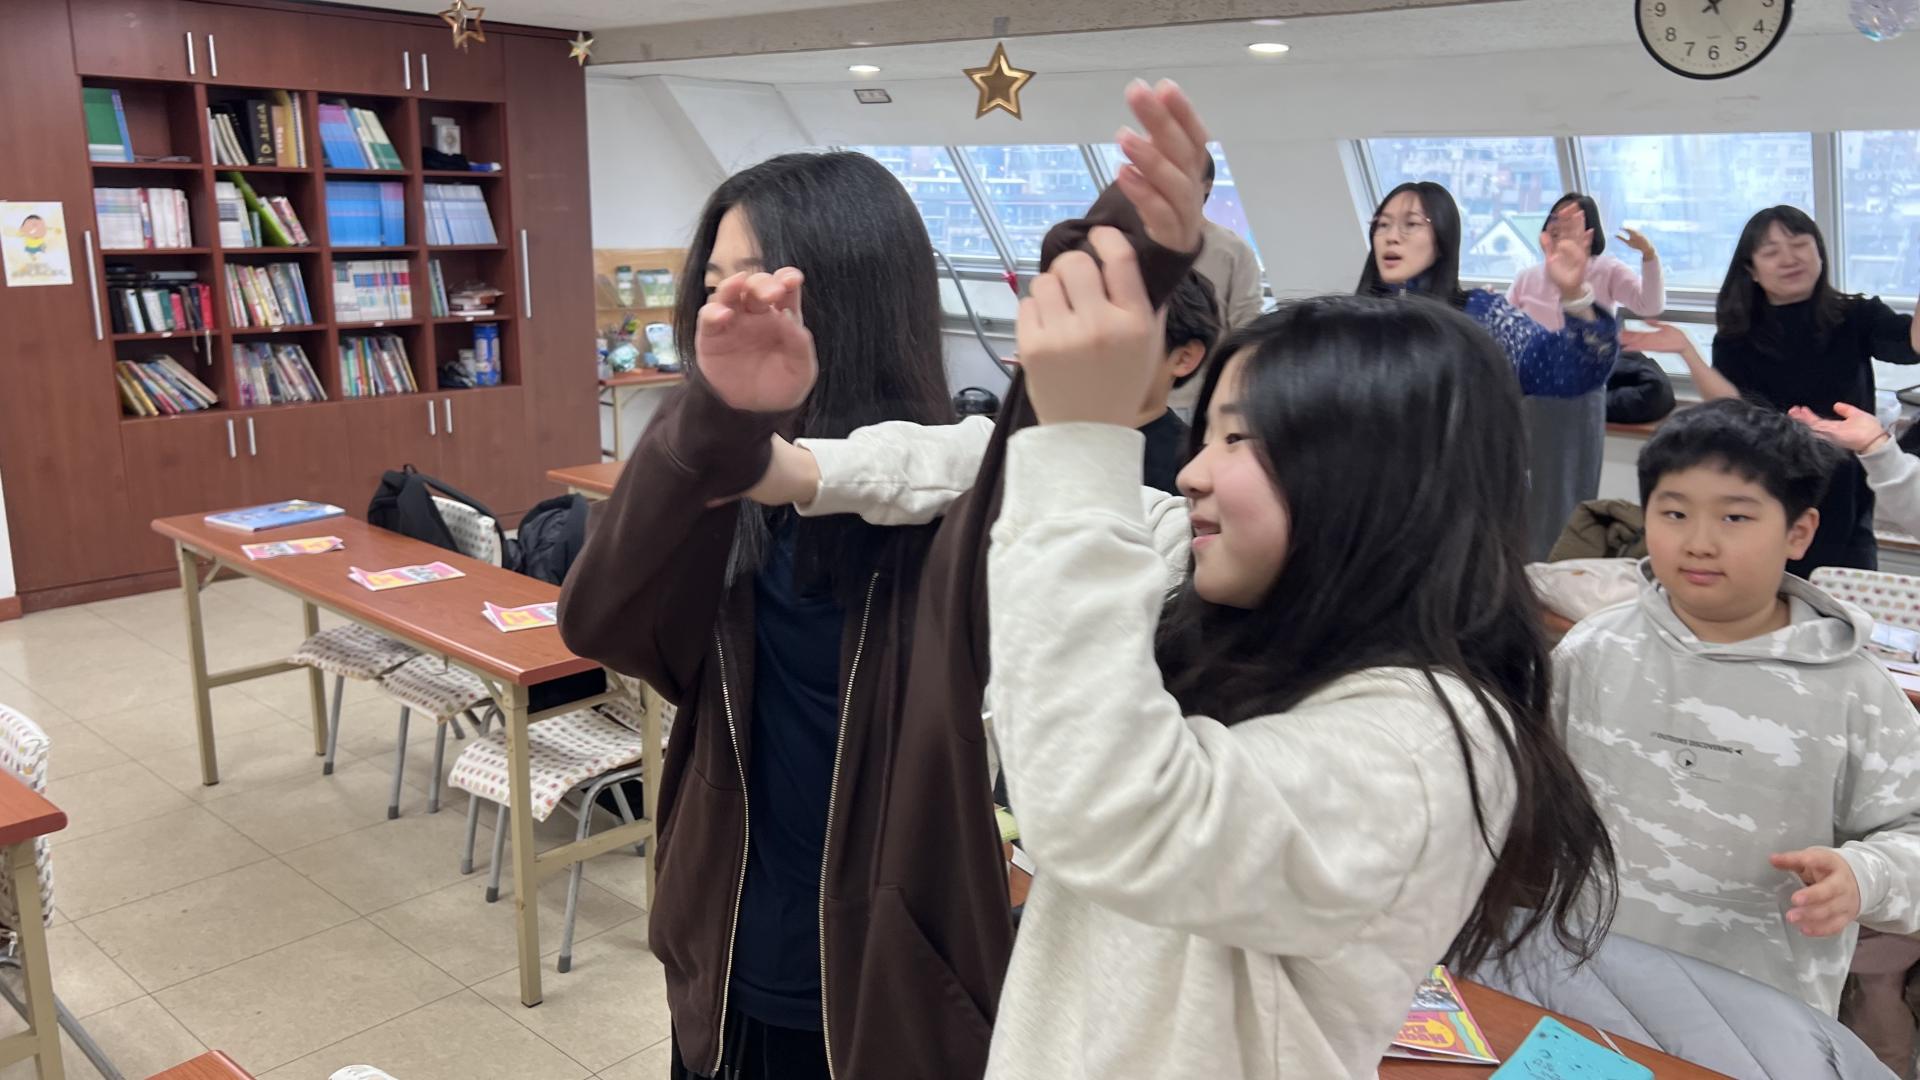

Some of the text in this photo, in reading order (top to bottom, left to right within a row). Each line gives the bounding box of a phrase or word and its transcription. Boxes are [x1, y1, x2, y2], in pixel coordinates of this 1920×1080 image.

[1654, 2, 1667, 17] 9
[1753, 19, 1765, 34] 4
[1665, 27, 1677, 42] 8
[1684, 41, 1696, 57] 7
[1735, 36, 1747, 52] 5
[1708, 45, 1720, 60] 6
